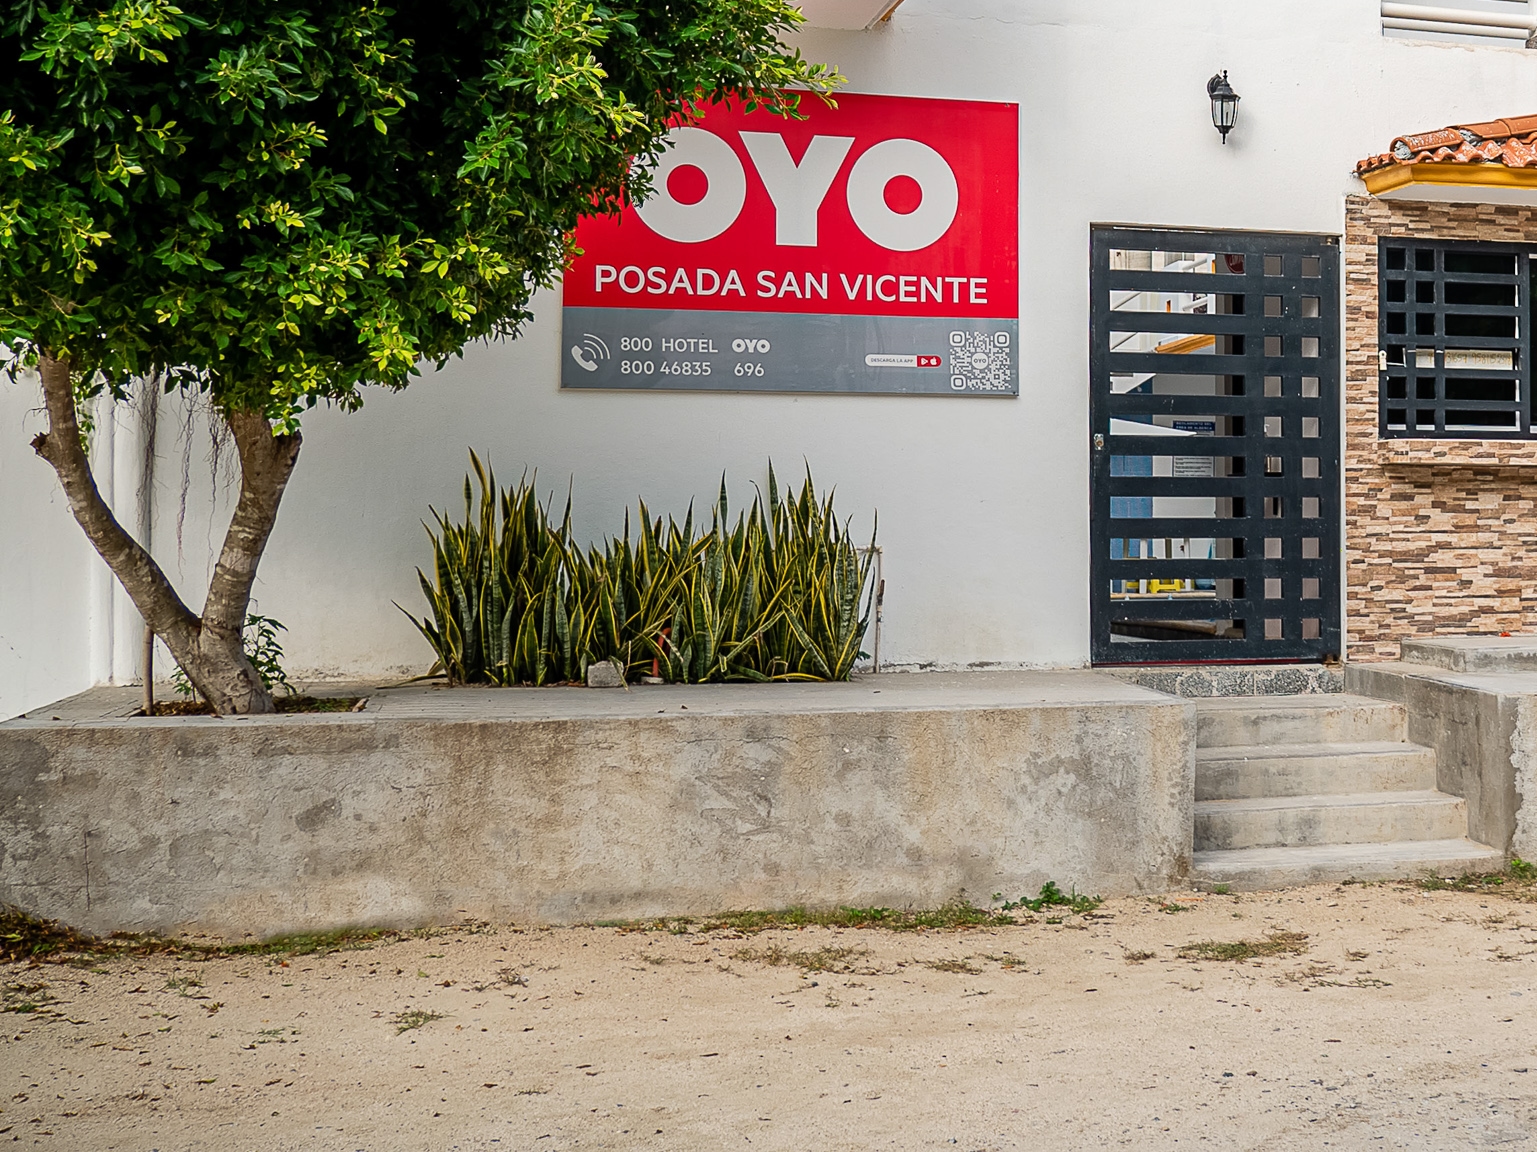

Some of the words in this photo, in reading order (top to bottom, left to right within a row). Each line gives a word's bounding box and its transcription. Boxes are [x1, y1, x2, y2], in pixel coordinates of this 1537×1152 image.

[629, 126, 959, 252] OYO
[595, 264, 747, 297] POSADA
[756, 270, 829, 300] SAN
[840, 273, 988, 304] VICENTE
[620, 336, 653, 352] 800
[661, 337, 718, 353] HOTEL
[731, 338, 771, 354] OYO
[620, 360, 655, 375] 800
[660, 361, 711, 376] 46835
[734, 362, 765, 377] 696
